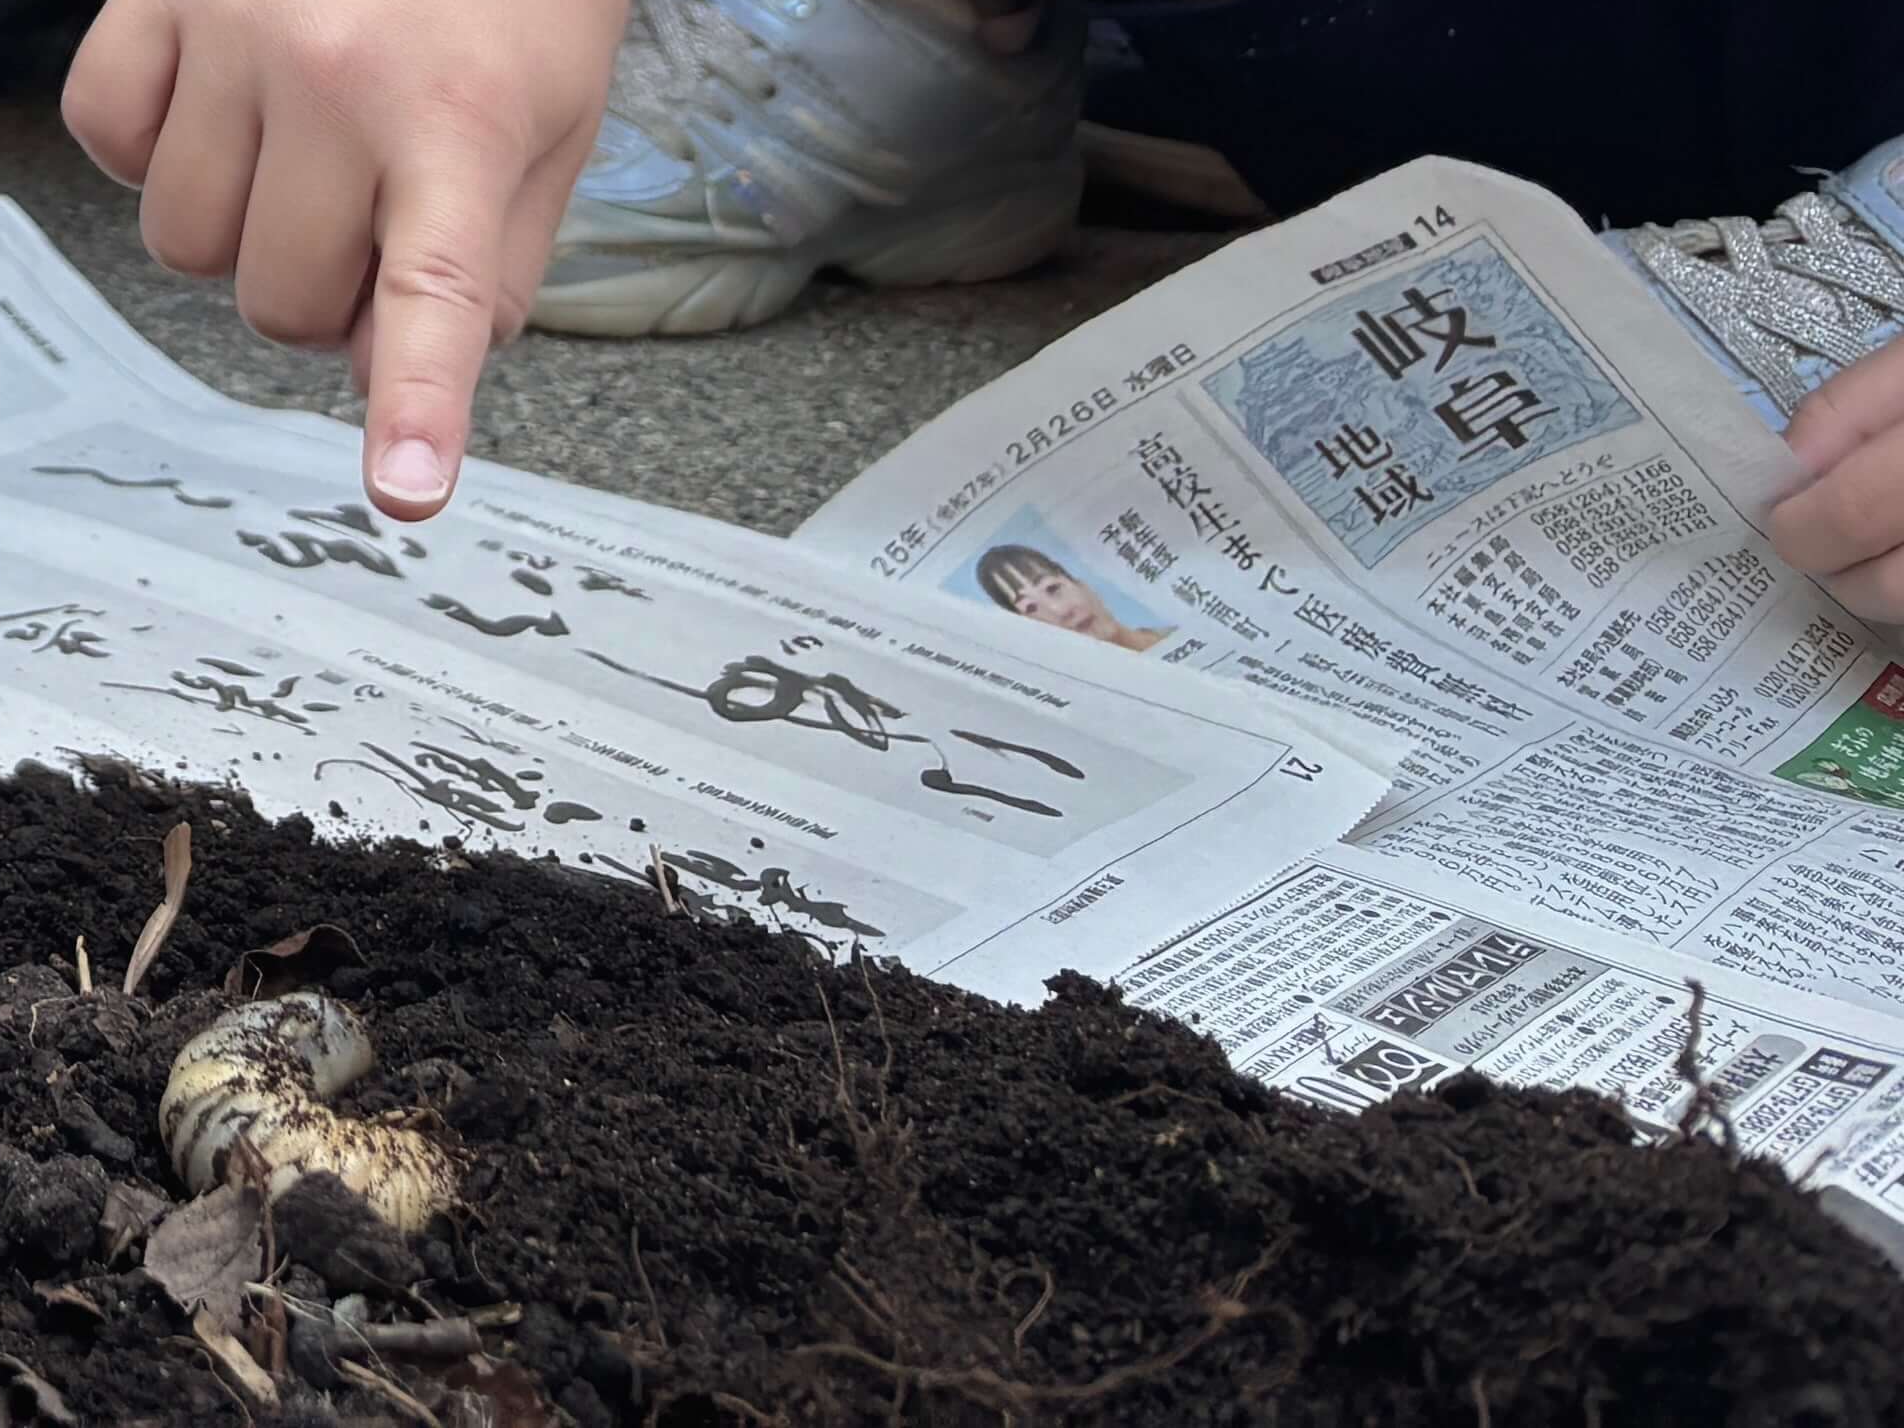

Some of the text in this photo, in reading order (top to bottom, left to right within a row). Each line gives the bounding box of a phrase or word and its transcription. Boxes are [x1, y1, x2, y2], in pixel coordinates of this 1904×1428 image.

[1414, 205, 1456, 237] 14
[1006, 388, 1118, 466] 2月26日
[1123, 343, 1197, 394] 水曜日
[1351, 287, 1560, 461] 岐阜
[1314, 424, 1435, 526] 地域
[1129, 431, 1534, 721] 高校生まで医療費無料
[1687, 566, 1777, 663] 058(264)1157
[1279, 755, 1323, 783] 21
[1375, 936, 1531, 1025] テレマルシェ
